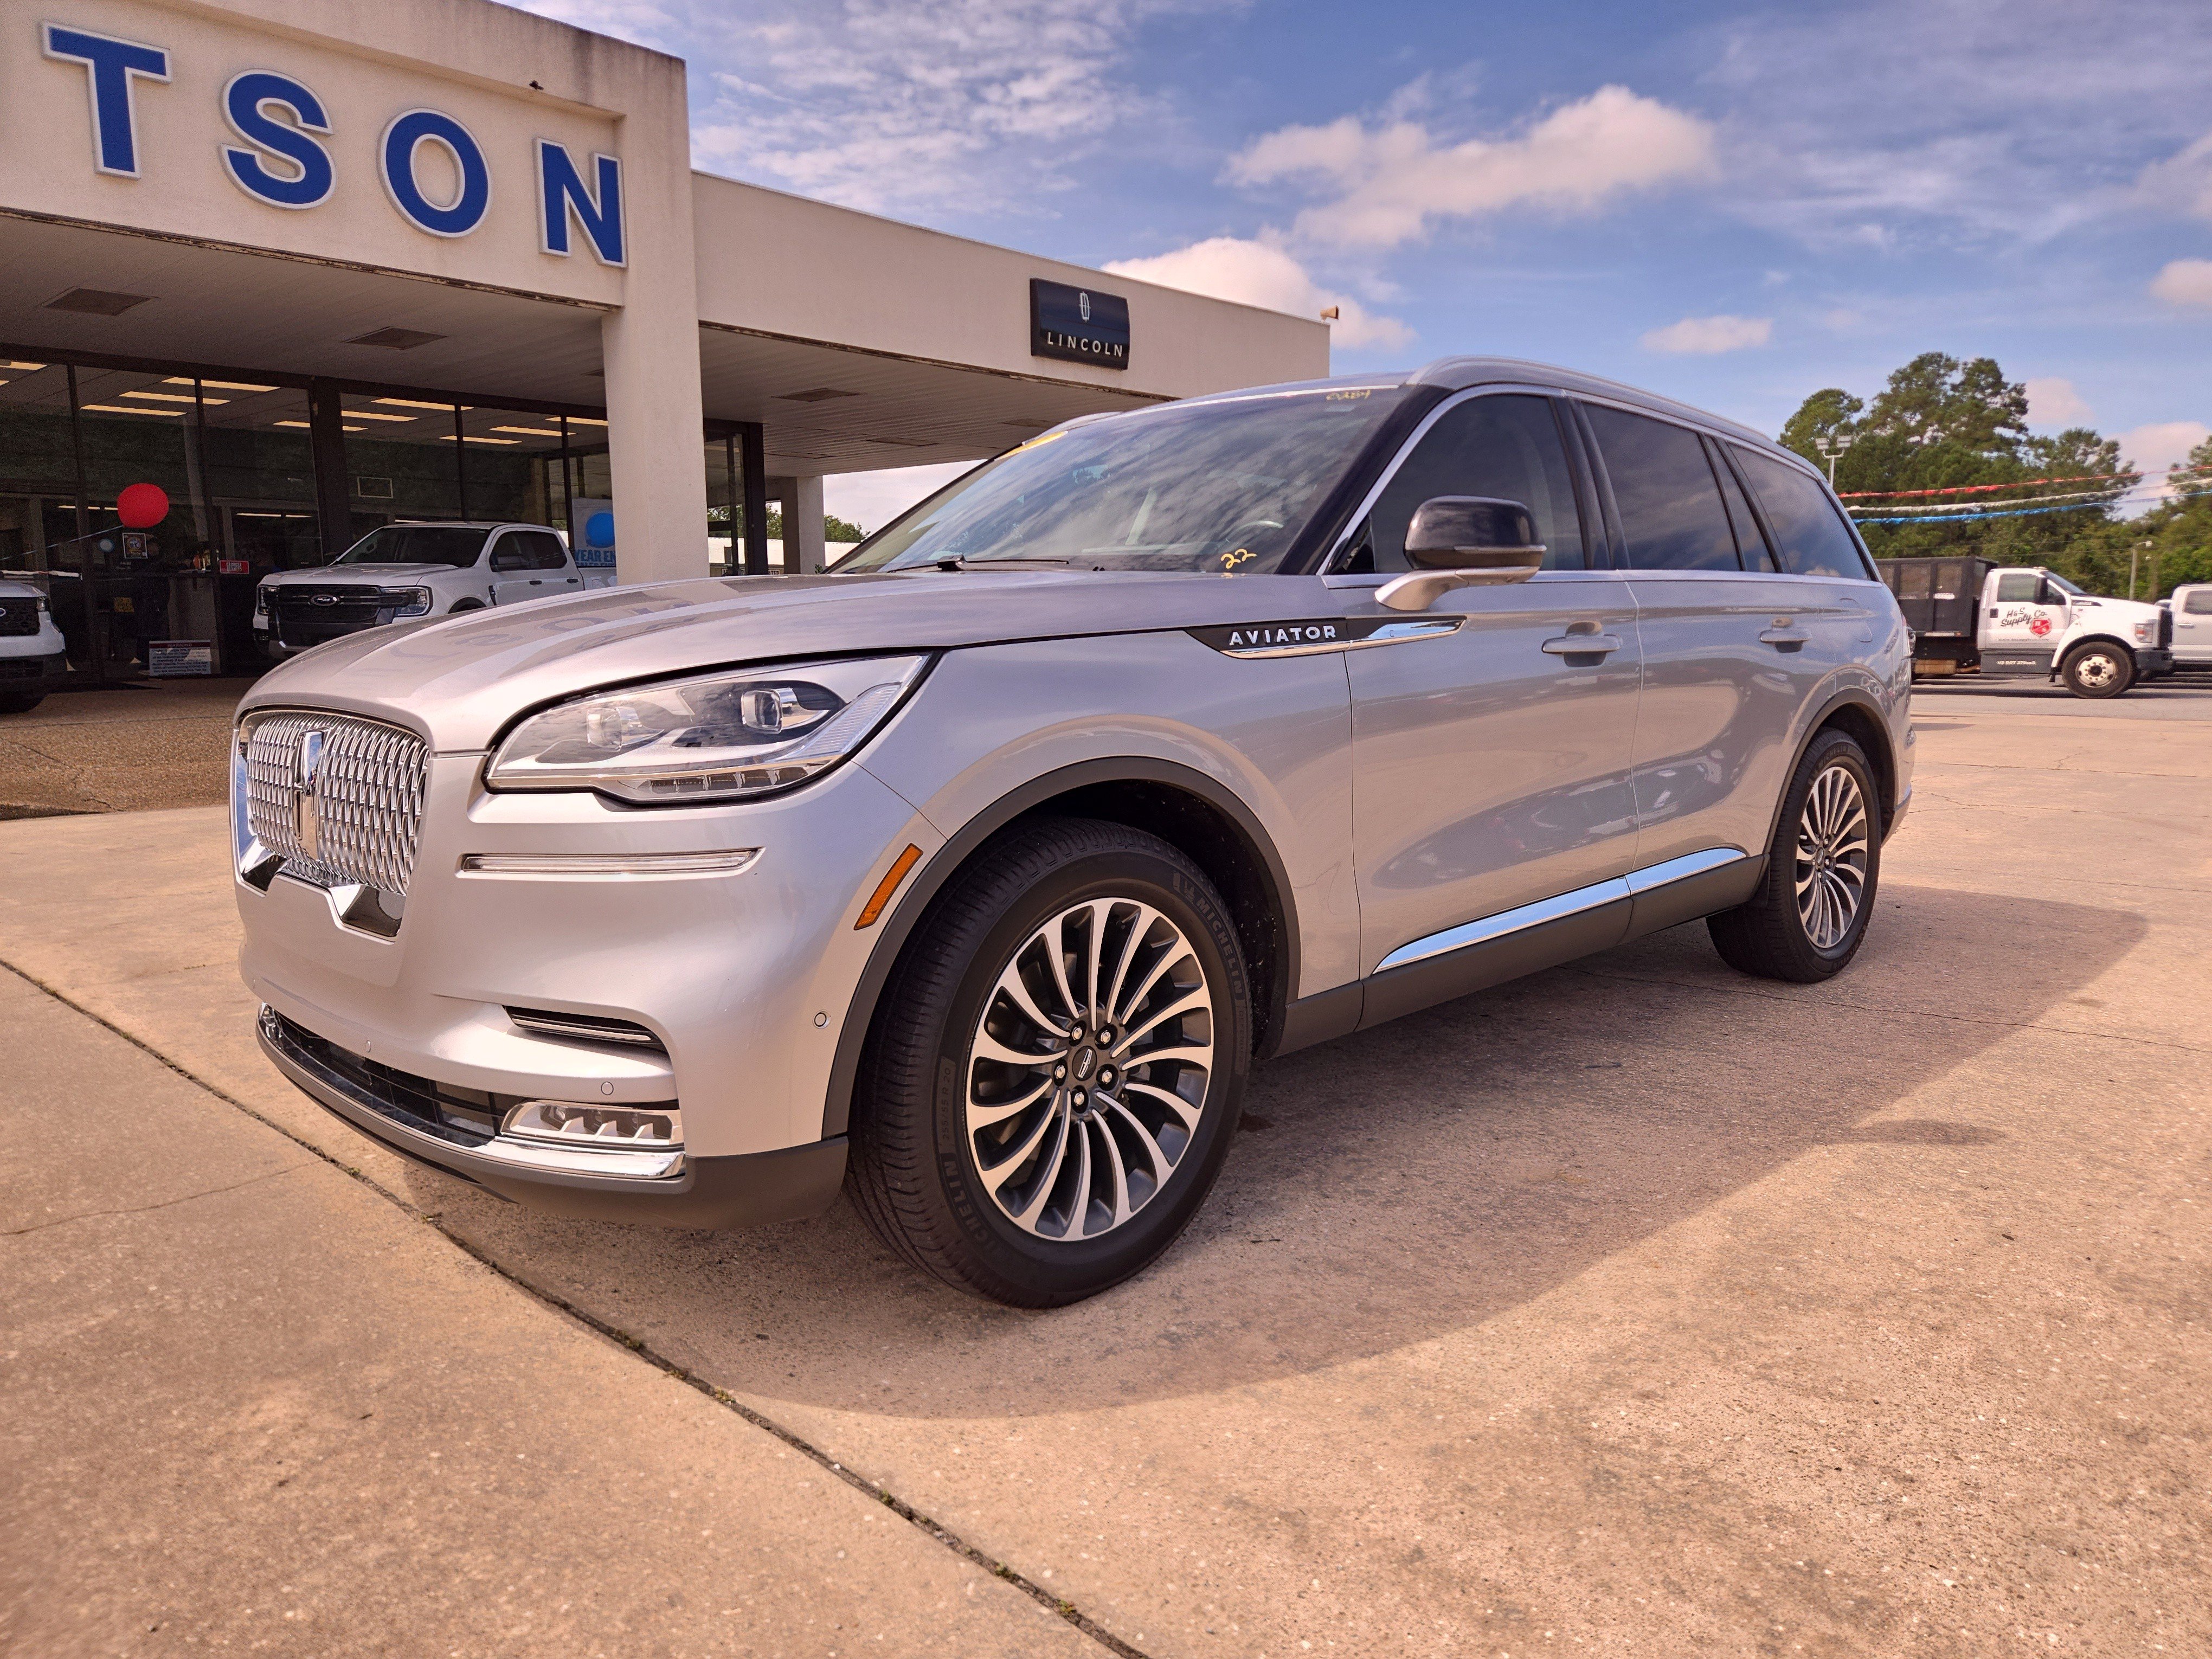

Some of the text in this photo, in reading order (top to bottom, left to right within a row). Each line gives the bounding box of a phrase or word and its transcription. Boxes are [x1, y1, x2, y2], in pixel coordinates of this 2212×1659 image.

[41, 20, 628, 269] TSON
[1047, 331, 1122, 357] LINCOLN
[575, 549, 601, 562] YEAR
[1220, 549, 1257, 569] 22
[2001, 610, 2048, 627] Supply Co.
[1229, 625, 1336, 646] AVIATOR
[1196, 897, 1243, 994] MICHELIN
[941, 1067, 951, 1141] 255/55 R 20
